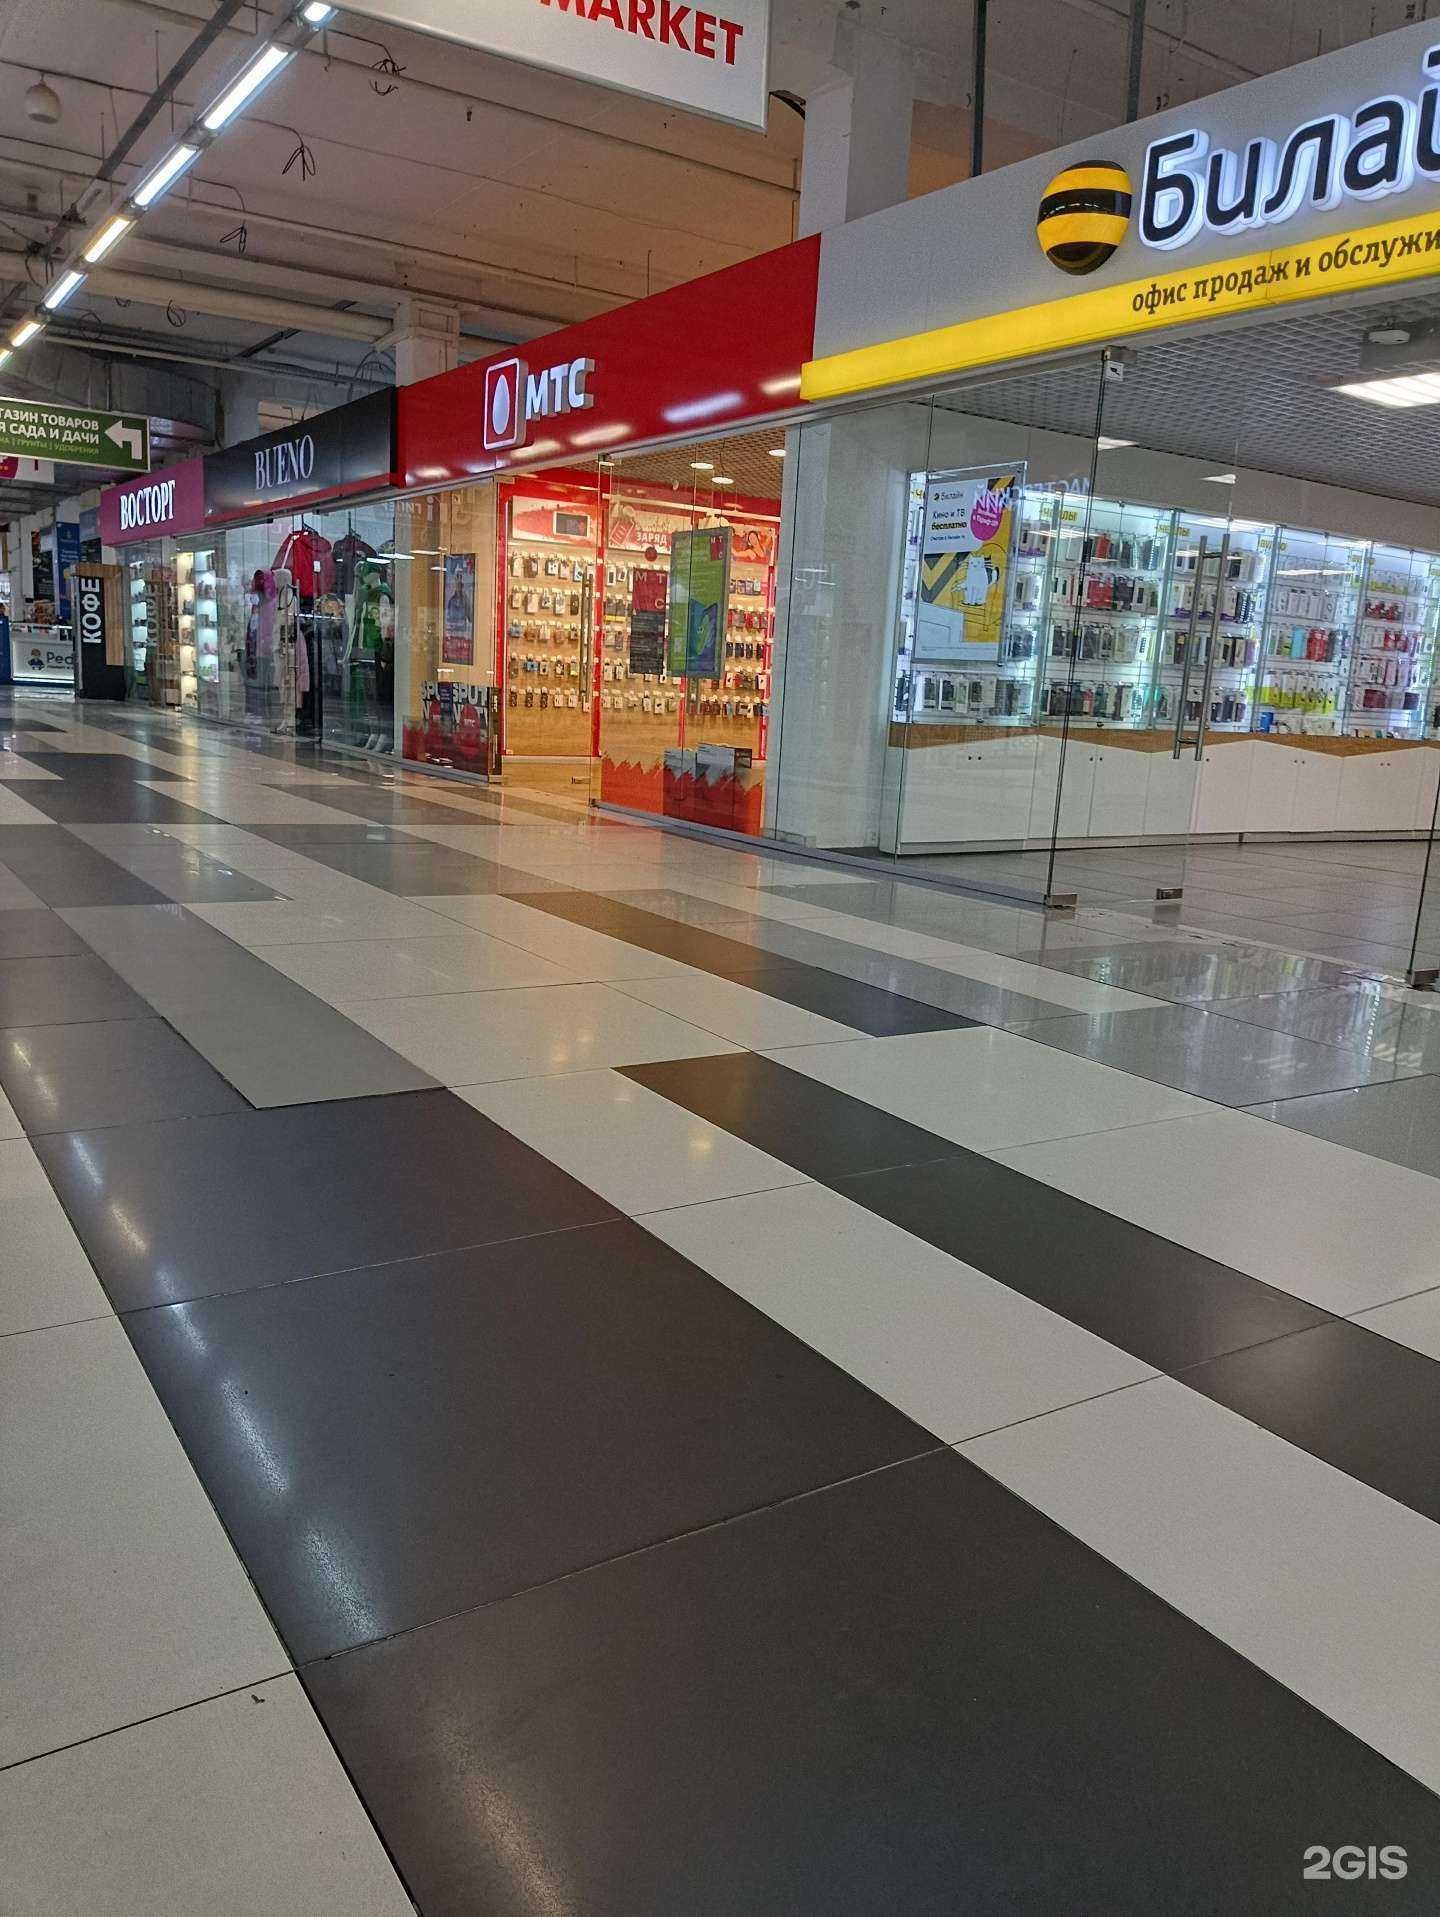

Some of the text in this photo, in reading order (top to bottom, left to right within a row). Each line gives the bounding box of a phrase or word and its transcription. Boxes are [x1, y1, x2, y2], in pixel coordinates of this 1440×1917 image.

[1132, 228, 1440, 314] офис продаж и обслужи
[525, 357, 592, 420] МТС
[9, 423, 46, 439] САДА
[49, 428, 59, 439] И
[62, 430, 99, 444] ДАЧИ
[41, 413, 99, 430] ТОВАРОВ
[255, 434, 314, 490] BUENO
[120, 479, 176, 531] ВОСТОРГ
[636, 532, 667, 546] ЗАРЯД
[81, 578, 102, 644] КОФЕ
